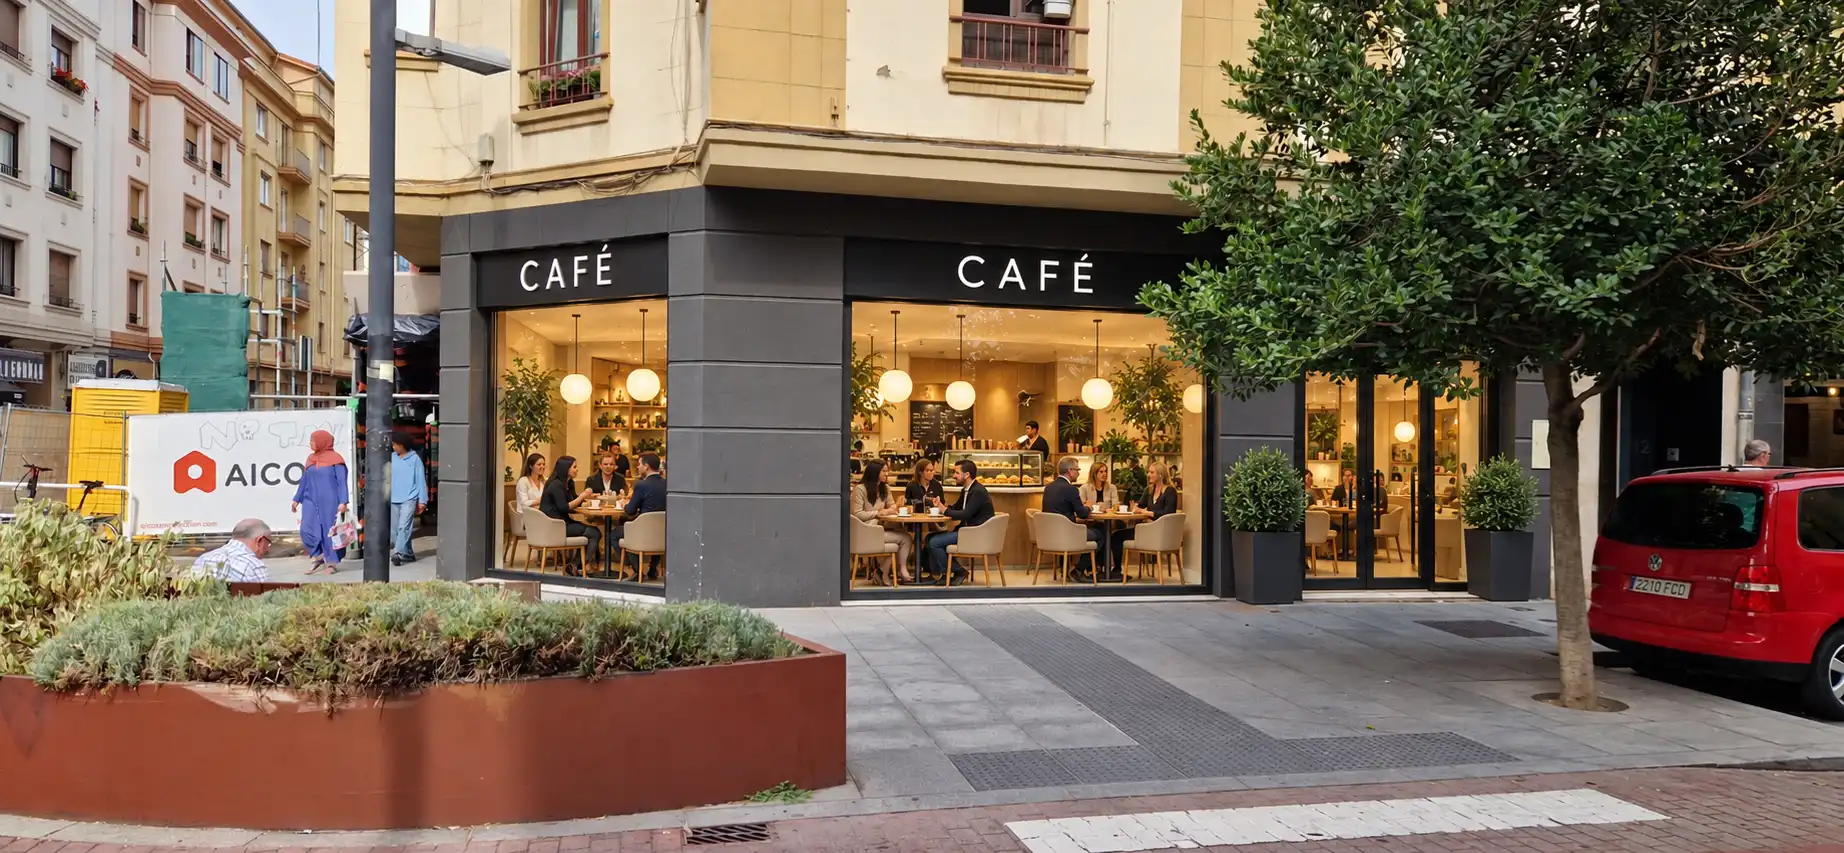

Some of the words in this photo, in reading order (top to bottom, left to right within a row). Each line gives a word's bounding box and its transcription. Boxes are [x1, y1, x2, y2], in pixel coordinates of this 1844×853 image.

[520, 244, 612, 292] CAFÉ
[957, 253, 1094, 294] CAFÉ
[225, 462, 306, 487] AICO
[1635, 579, 1663, 593] 2210
[1663, 582, 1686, 596] FCD
